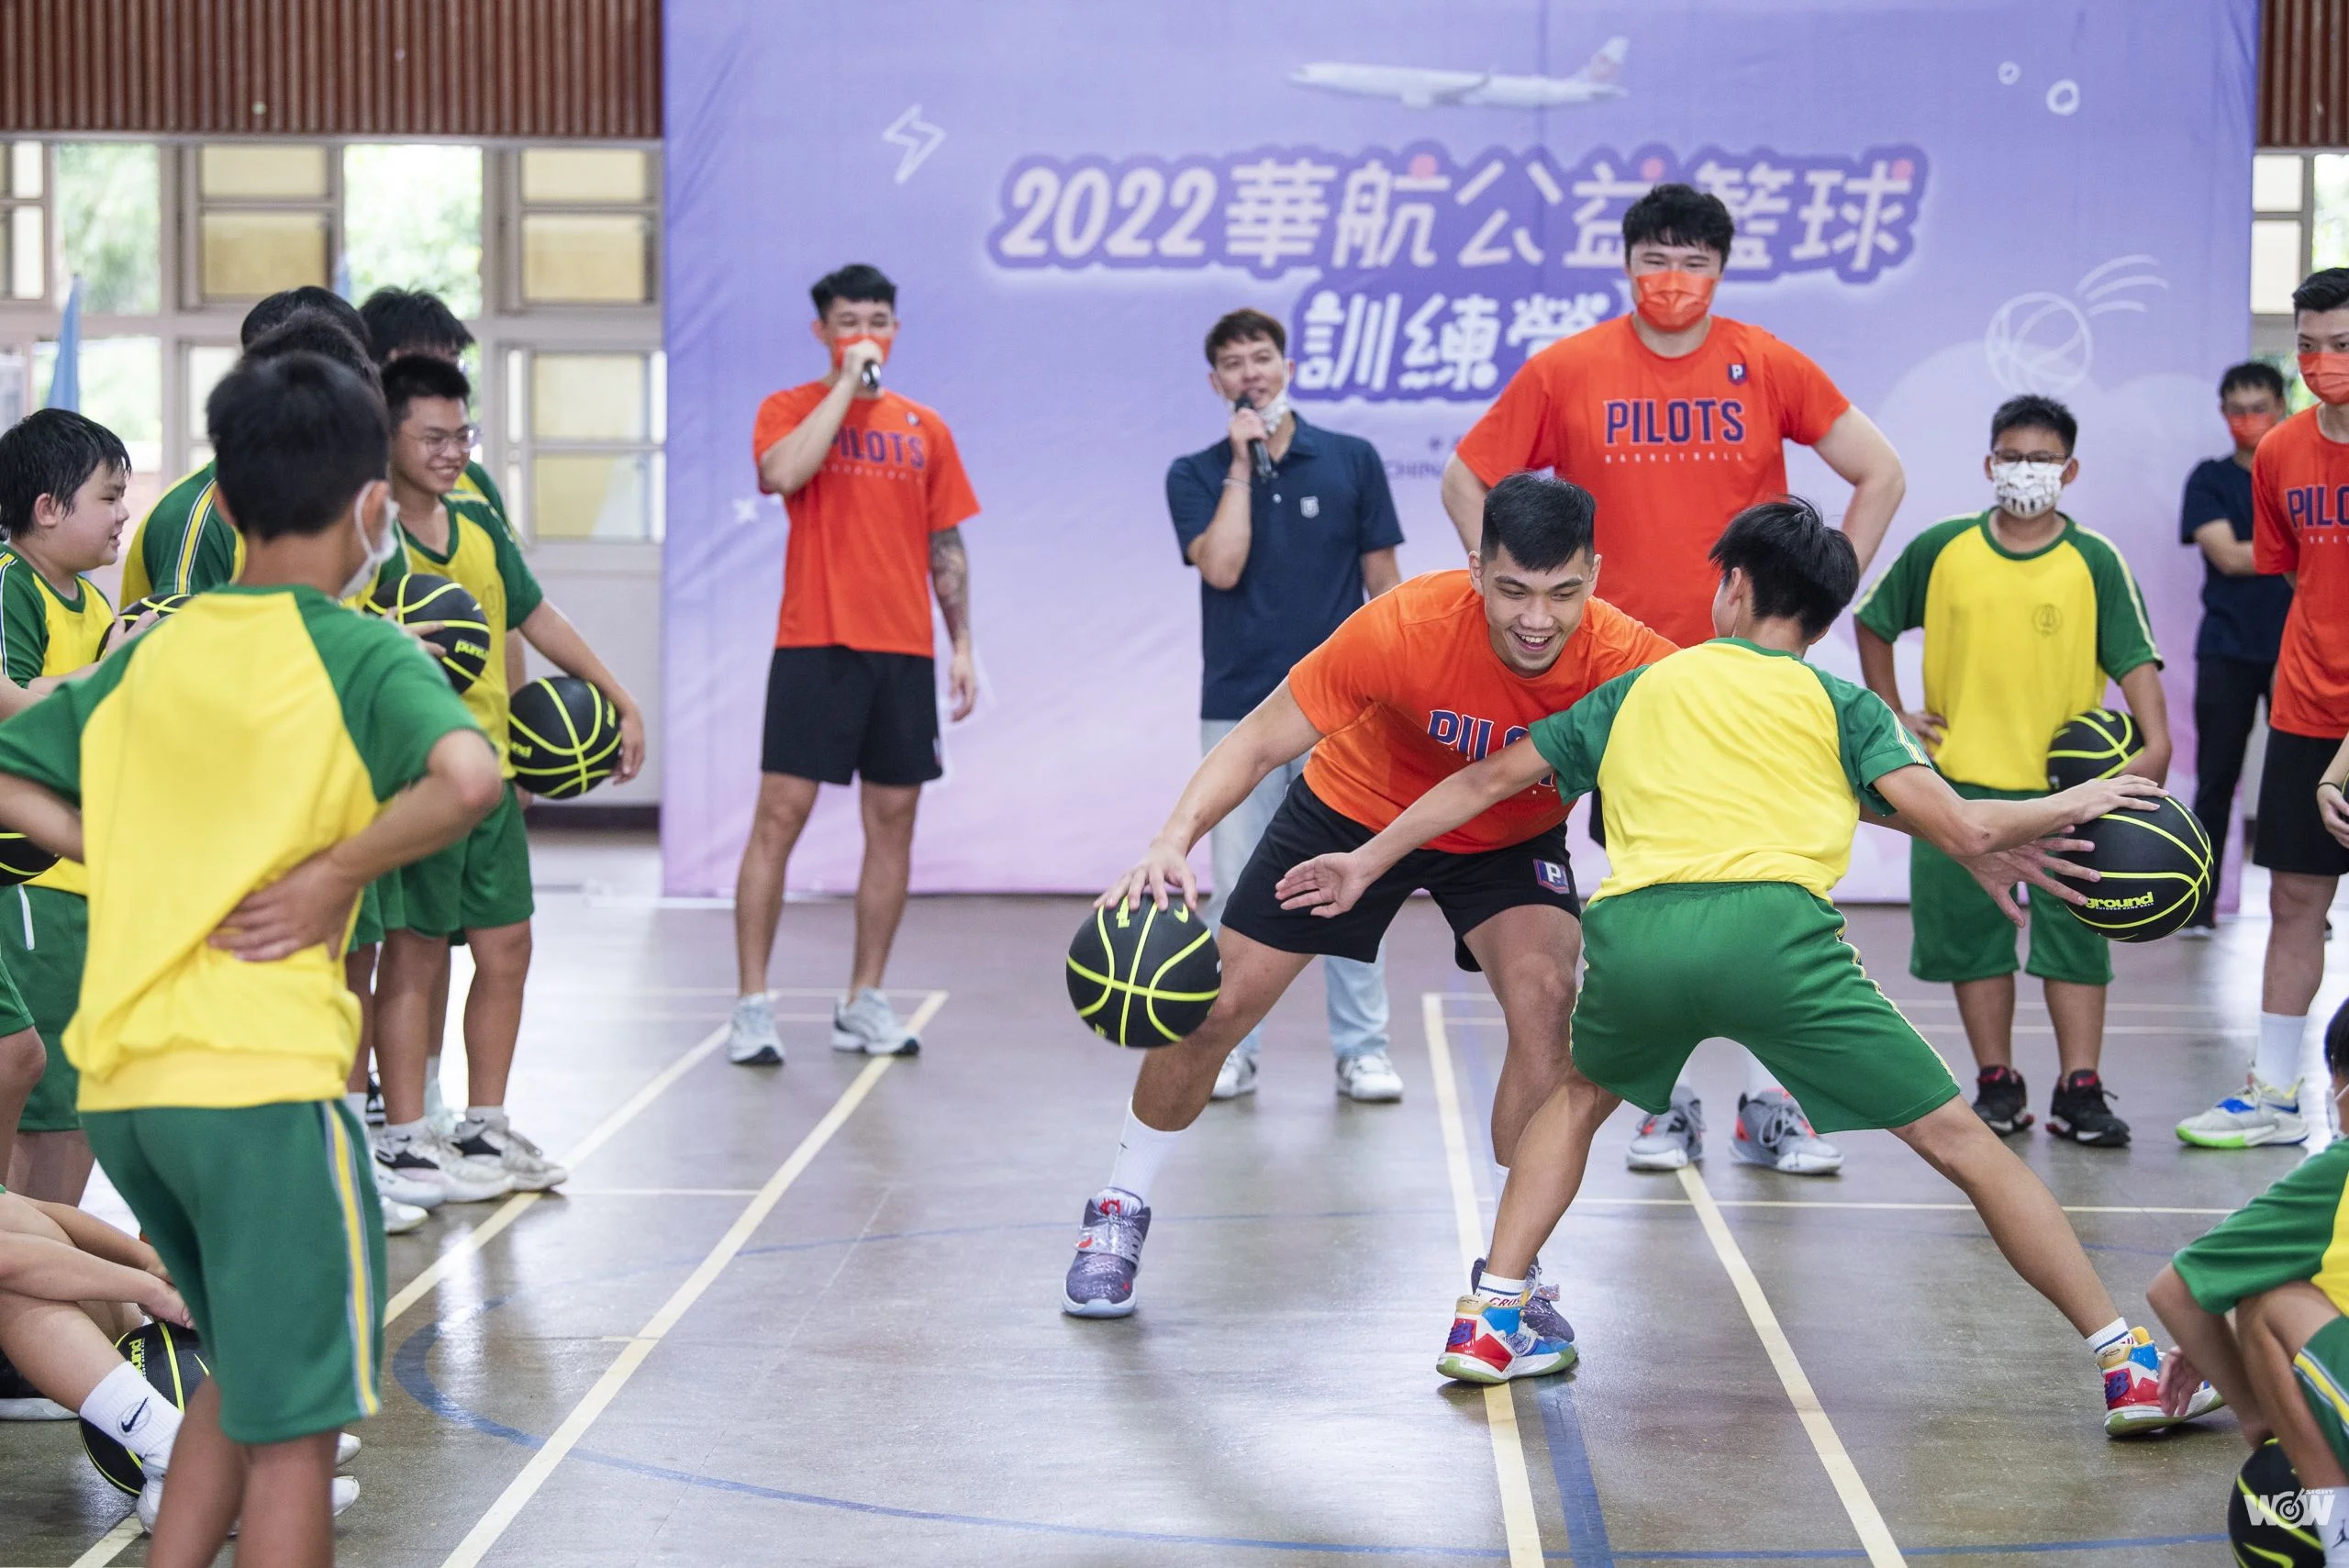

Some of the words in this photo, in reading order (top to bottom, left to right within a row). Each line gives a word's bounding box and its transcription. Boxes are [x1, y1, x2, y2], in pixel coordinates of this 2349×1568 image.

[1603, 397, 1746, 447] PILOTS
[831, 423, 927, 472] ILOTS
[2085, 891, 2154, 909] ground
